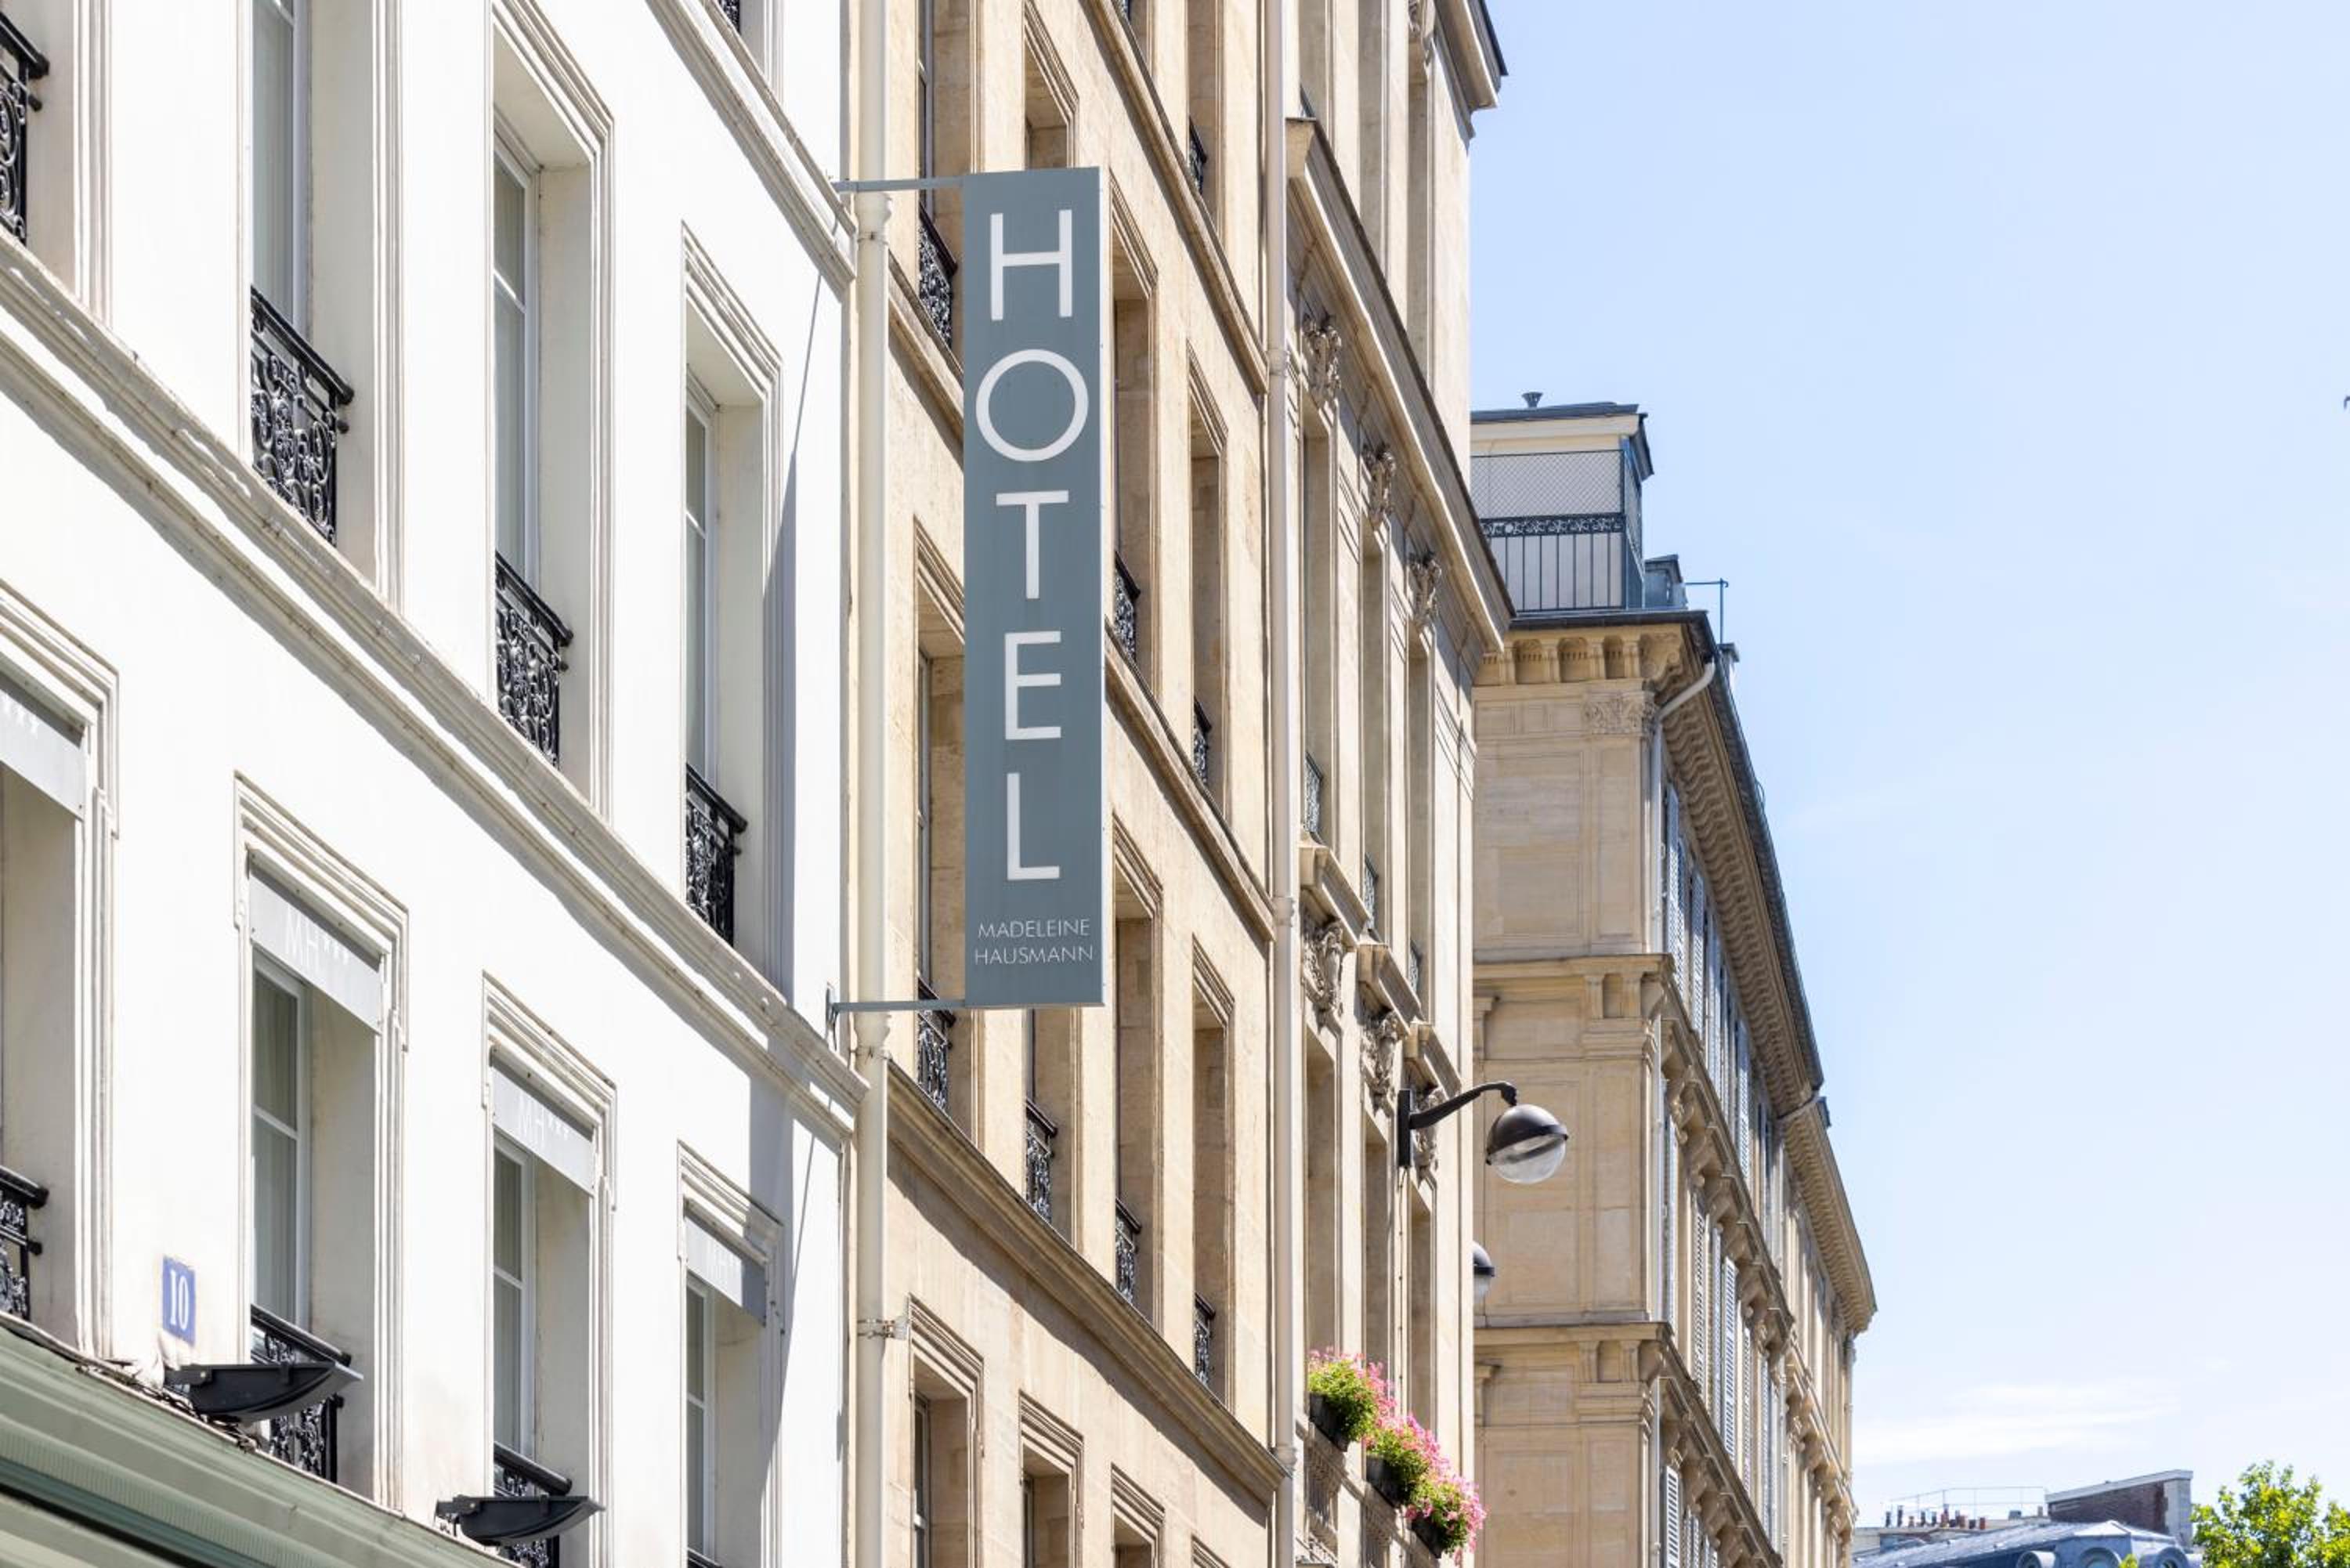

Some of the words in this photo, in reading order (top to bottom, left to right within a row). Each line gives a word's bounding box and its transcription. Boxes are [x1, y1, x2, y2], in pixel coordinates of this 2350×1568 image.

[976, 209, 1088, 880] HOTEL
[978, 919, 1090, 939] MADELEINE
[974, 945, 1094, 965] HAUSMANN
[170, 1269, 189, 1331] 10
